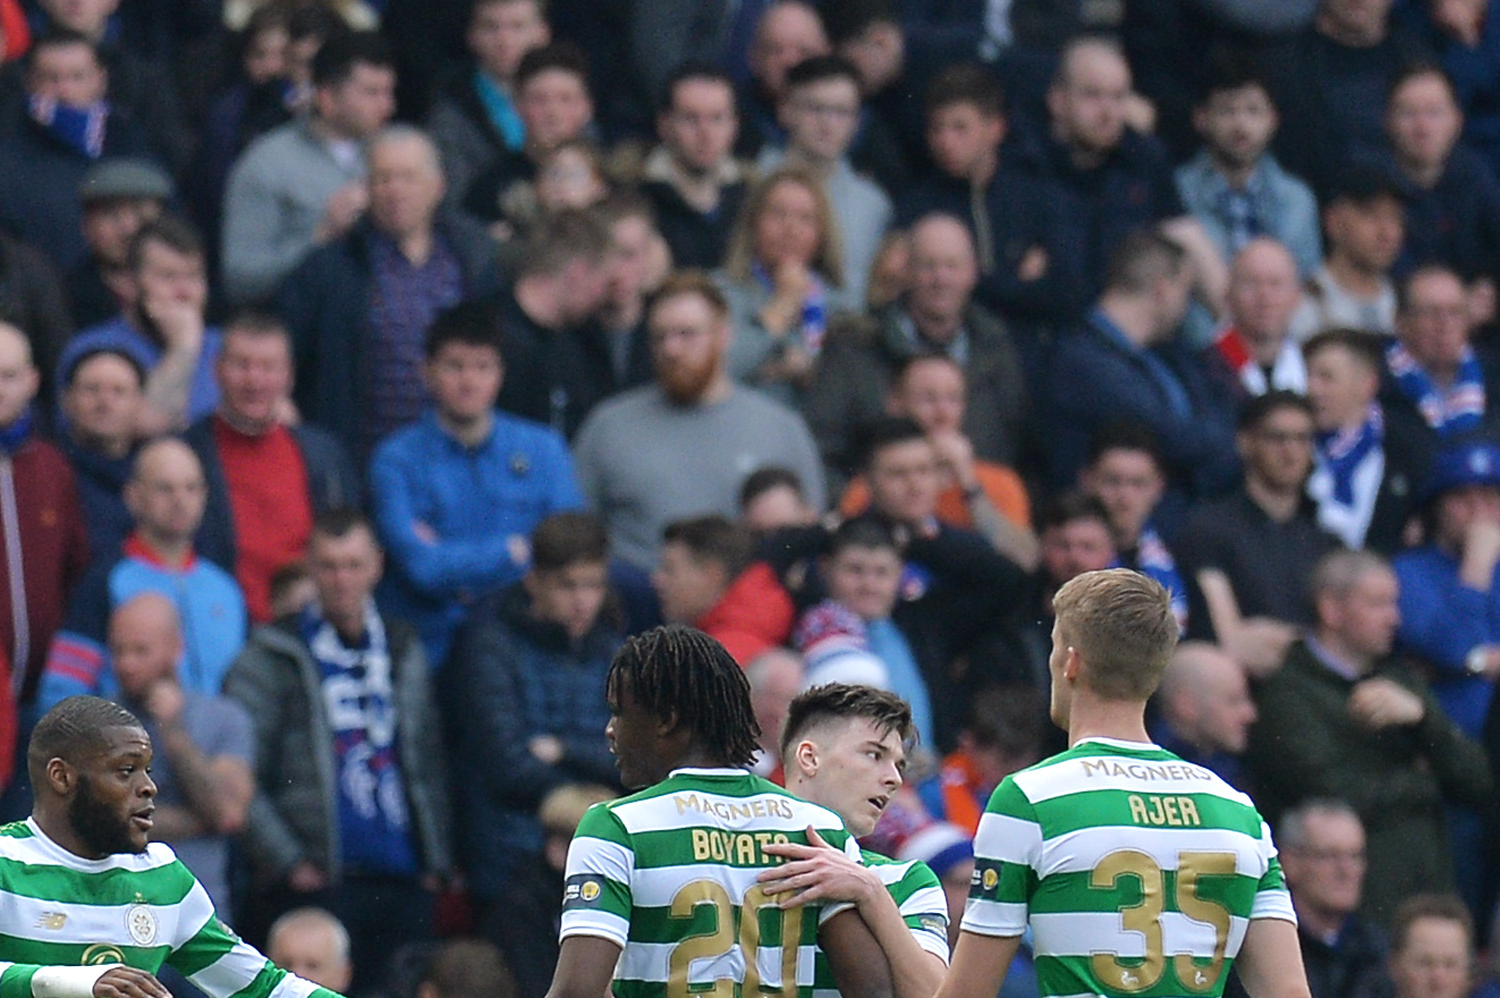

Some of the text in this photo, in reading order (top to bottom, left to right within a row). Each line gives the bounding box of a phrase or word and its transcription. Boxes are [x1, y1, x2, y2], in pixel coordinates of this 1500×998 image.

[1082, 760, 1211, 782] MAGNERS
[673, 794, 794, 820] MAGNERS
[1128, 795, 1200, 825] AJER
[1088, 847, 1239, 994] 35
